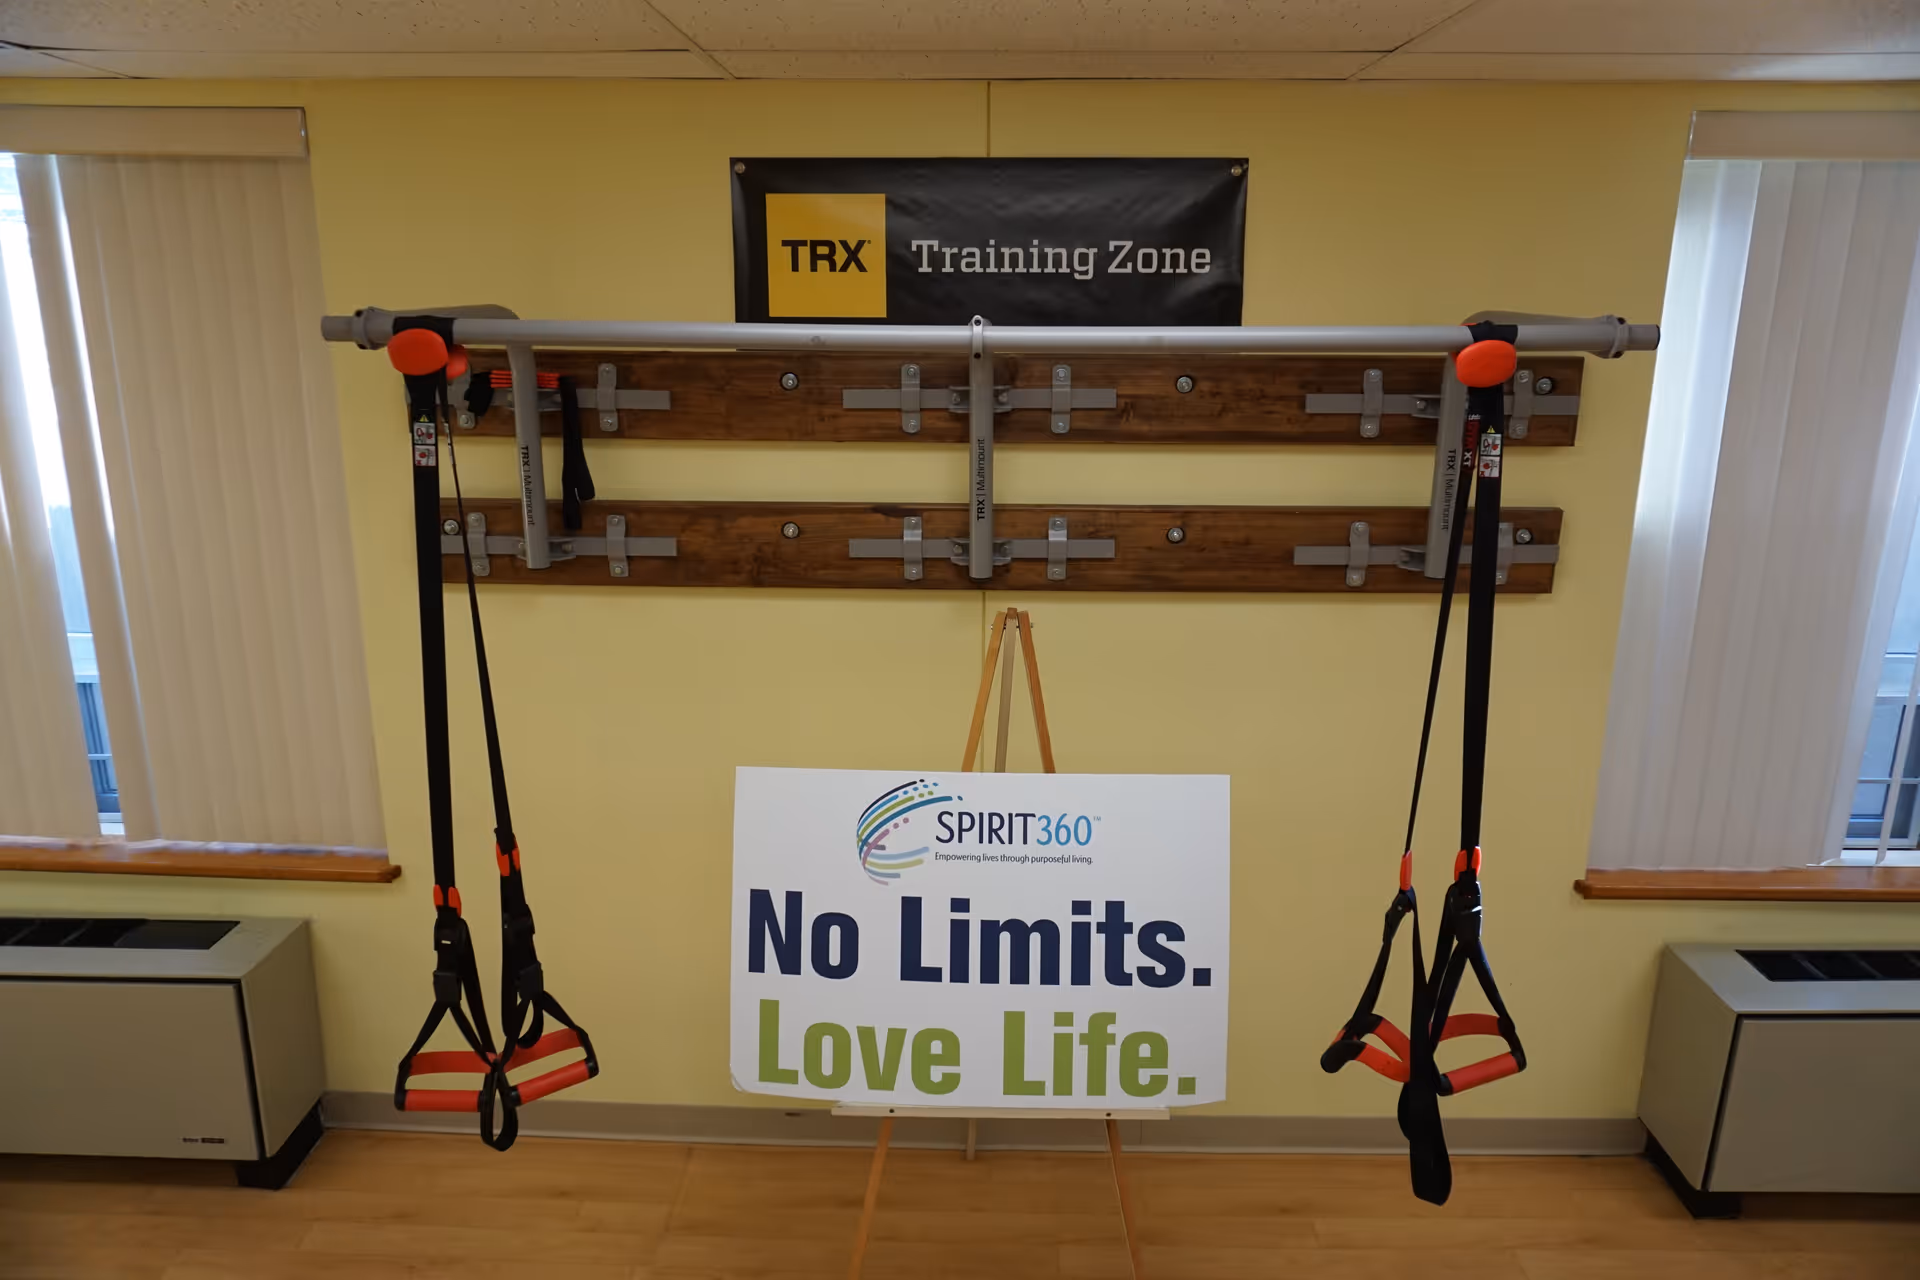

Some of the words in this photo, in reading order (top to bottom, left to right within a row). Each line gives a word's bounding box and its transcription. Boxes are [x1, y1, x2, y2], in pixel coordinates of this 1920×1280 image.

[781, 239, 868, 273] TRX
[911, 239, 1097, 280] Training
[1107, 240, 1211, 275] Zone
[521, 446, 531, 467] TRX
[976, 438, 986, 491] Multimount
[1447, 449, 1457, 470] TRX
[523, 475, 535, 526] Multimount
[976, 498, 986, 521] TRX
[934, 851, 982, 864] Empowering
[982, 852, 999, 863] lives
[1000, 852, 1030, 865] through
[1030, 853, 1071, 866] purposeful
[1072, 854, 1094, 866] living.
[748, 888, 860, 980] No
[900, 895, 1212, 988] Limits.
[758, 998, 961, 1096] Love
[1002, 1010, 1196, 1098] Life.
